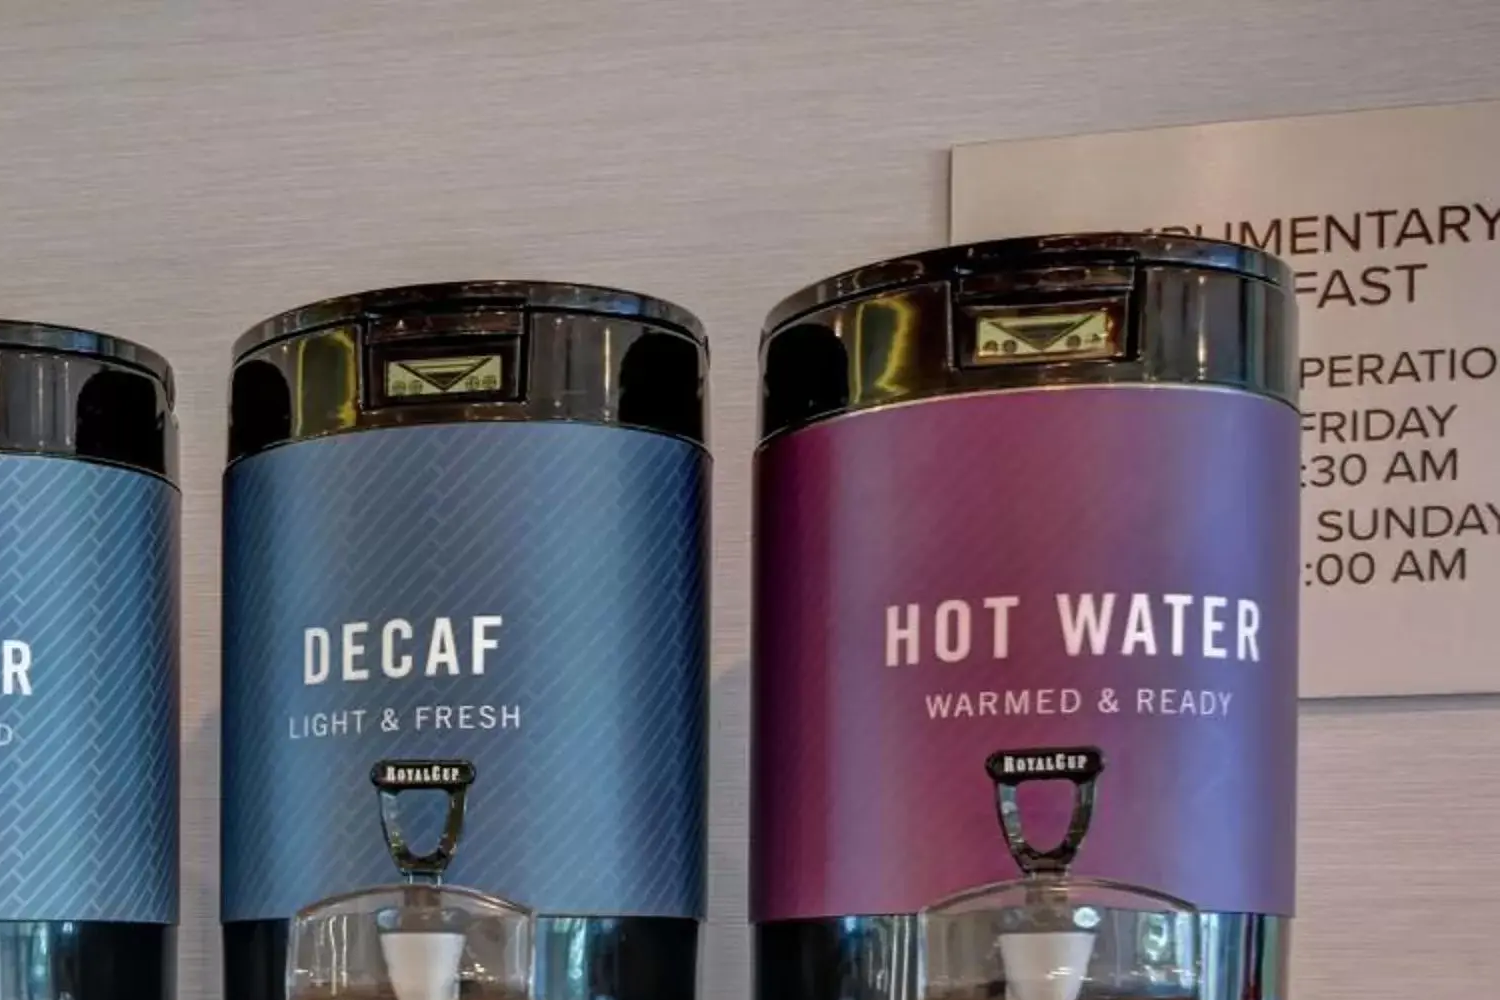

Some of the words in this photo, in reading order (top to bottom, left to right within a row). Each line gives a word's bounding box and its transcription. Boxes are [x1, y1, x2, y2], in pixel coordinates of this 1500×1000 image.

[1383, 448, 1458, 484] AM
[1391, 547, 1466, 583] AM
[885, 596, 1019, 667] HOT
[1056, 593, 1261, 662] WATER
[303, 615, 503, 685] DECAF
[925, 689, 1082, 719] WARMED
[1097, 687, 1120, 714] &
[1137, 689, 1234, 717] READY
[289, 709, 366, 739] LIGHT
[380, 708, 400, 732] &
[415, 705, 521, 730] FRESH
